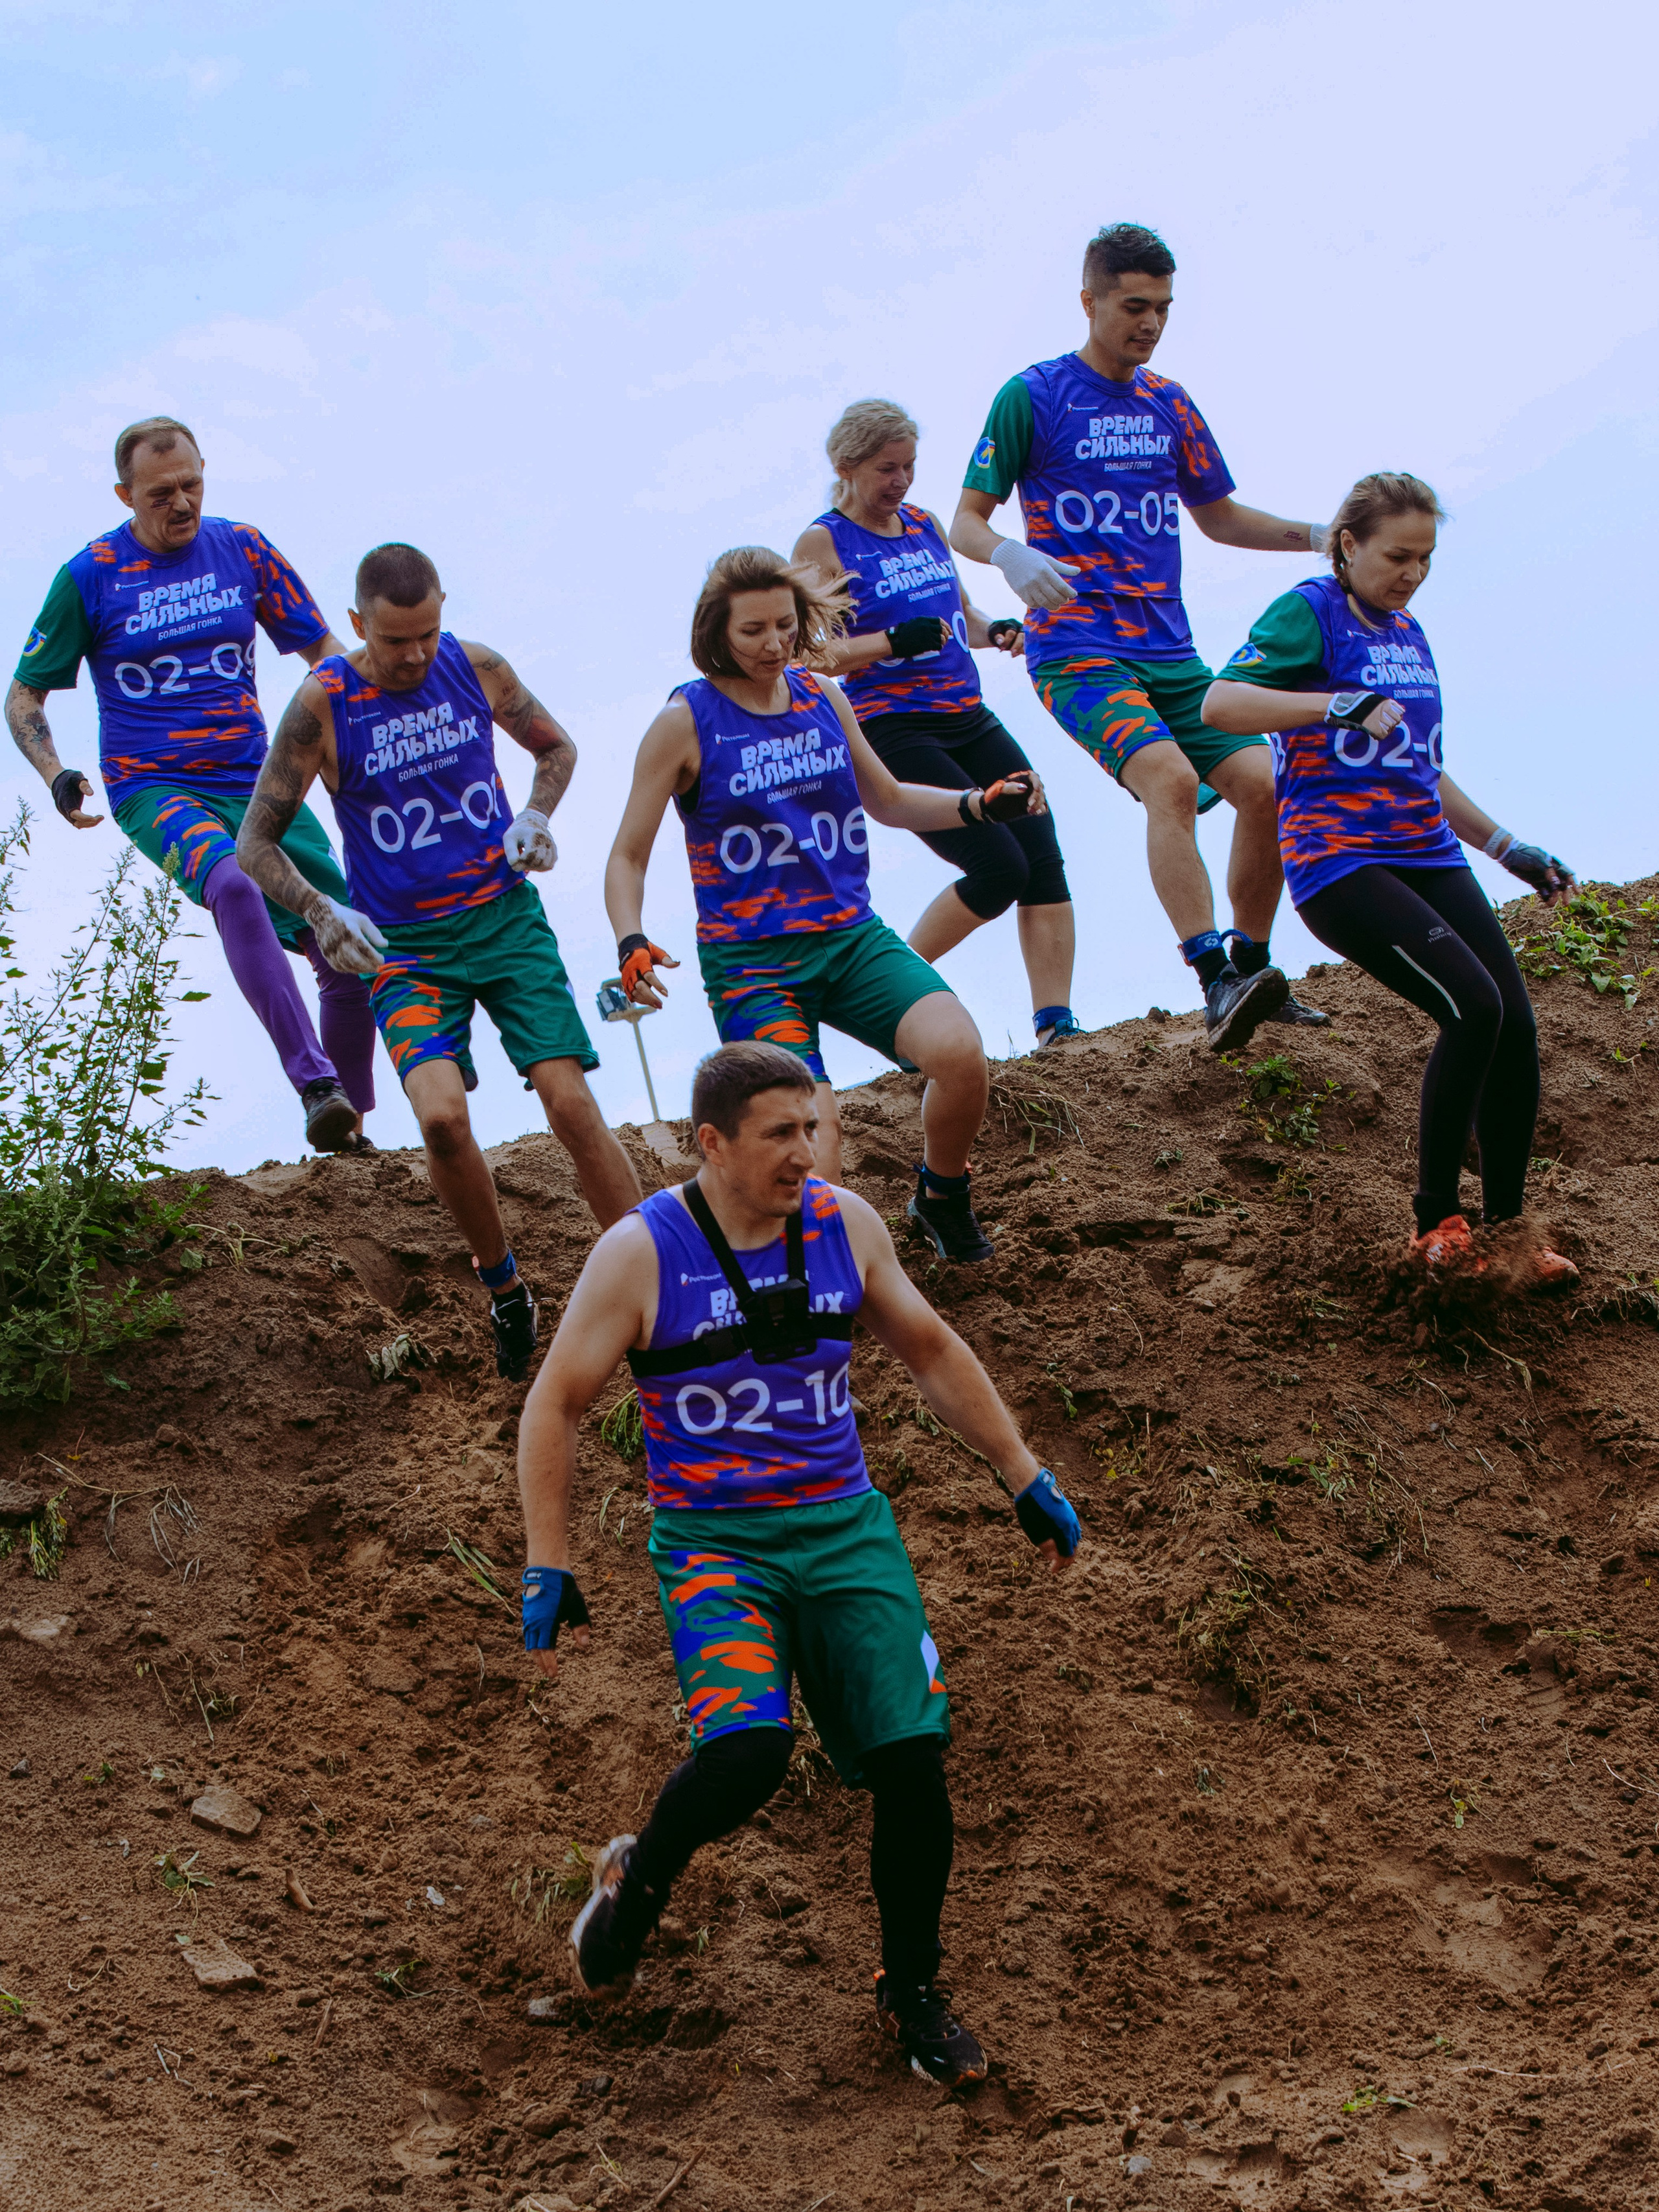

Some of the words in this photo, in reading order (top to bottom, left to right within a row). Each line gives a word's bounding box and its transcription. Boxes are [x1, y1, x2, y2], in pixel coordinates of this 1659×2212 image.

[1075, 435, 1171, 460] СИЛЬНЫХ
[1089, 415, 1154, 438] ВРЕМЯ
[1055, 490, 1179, 537] 02-05
[125, 585, 244, 636] СИЛЬНЫХ
[138, 573, 217, 612] ВРЕМЯ
[158, 623, 196, 641] БОЛЬШАЯ
[197, 616, 223, 630] ГОНКА
[364, 716, 480, 776] СИЛЬНЫХ
[371, 701, 454, 750] ВРЕМЯ
[398, 762, 433, 783] БОЛЬШАЯ
[434, 753, 459, 771] ГОНКА
[728, 745, 847, 797] СИЛЬНЫХ
[740, 727, 822, 771] ВРЕМЯ
[767, 786, 798, 805] БОЛЬШАЯ
[798, 780, 822, 795] ГОНКА
[719, 805, 868, 875] 02-06
[676, 1361, 850, 1436] 02-10
